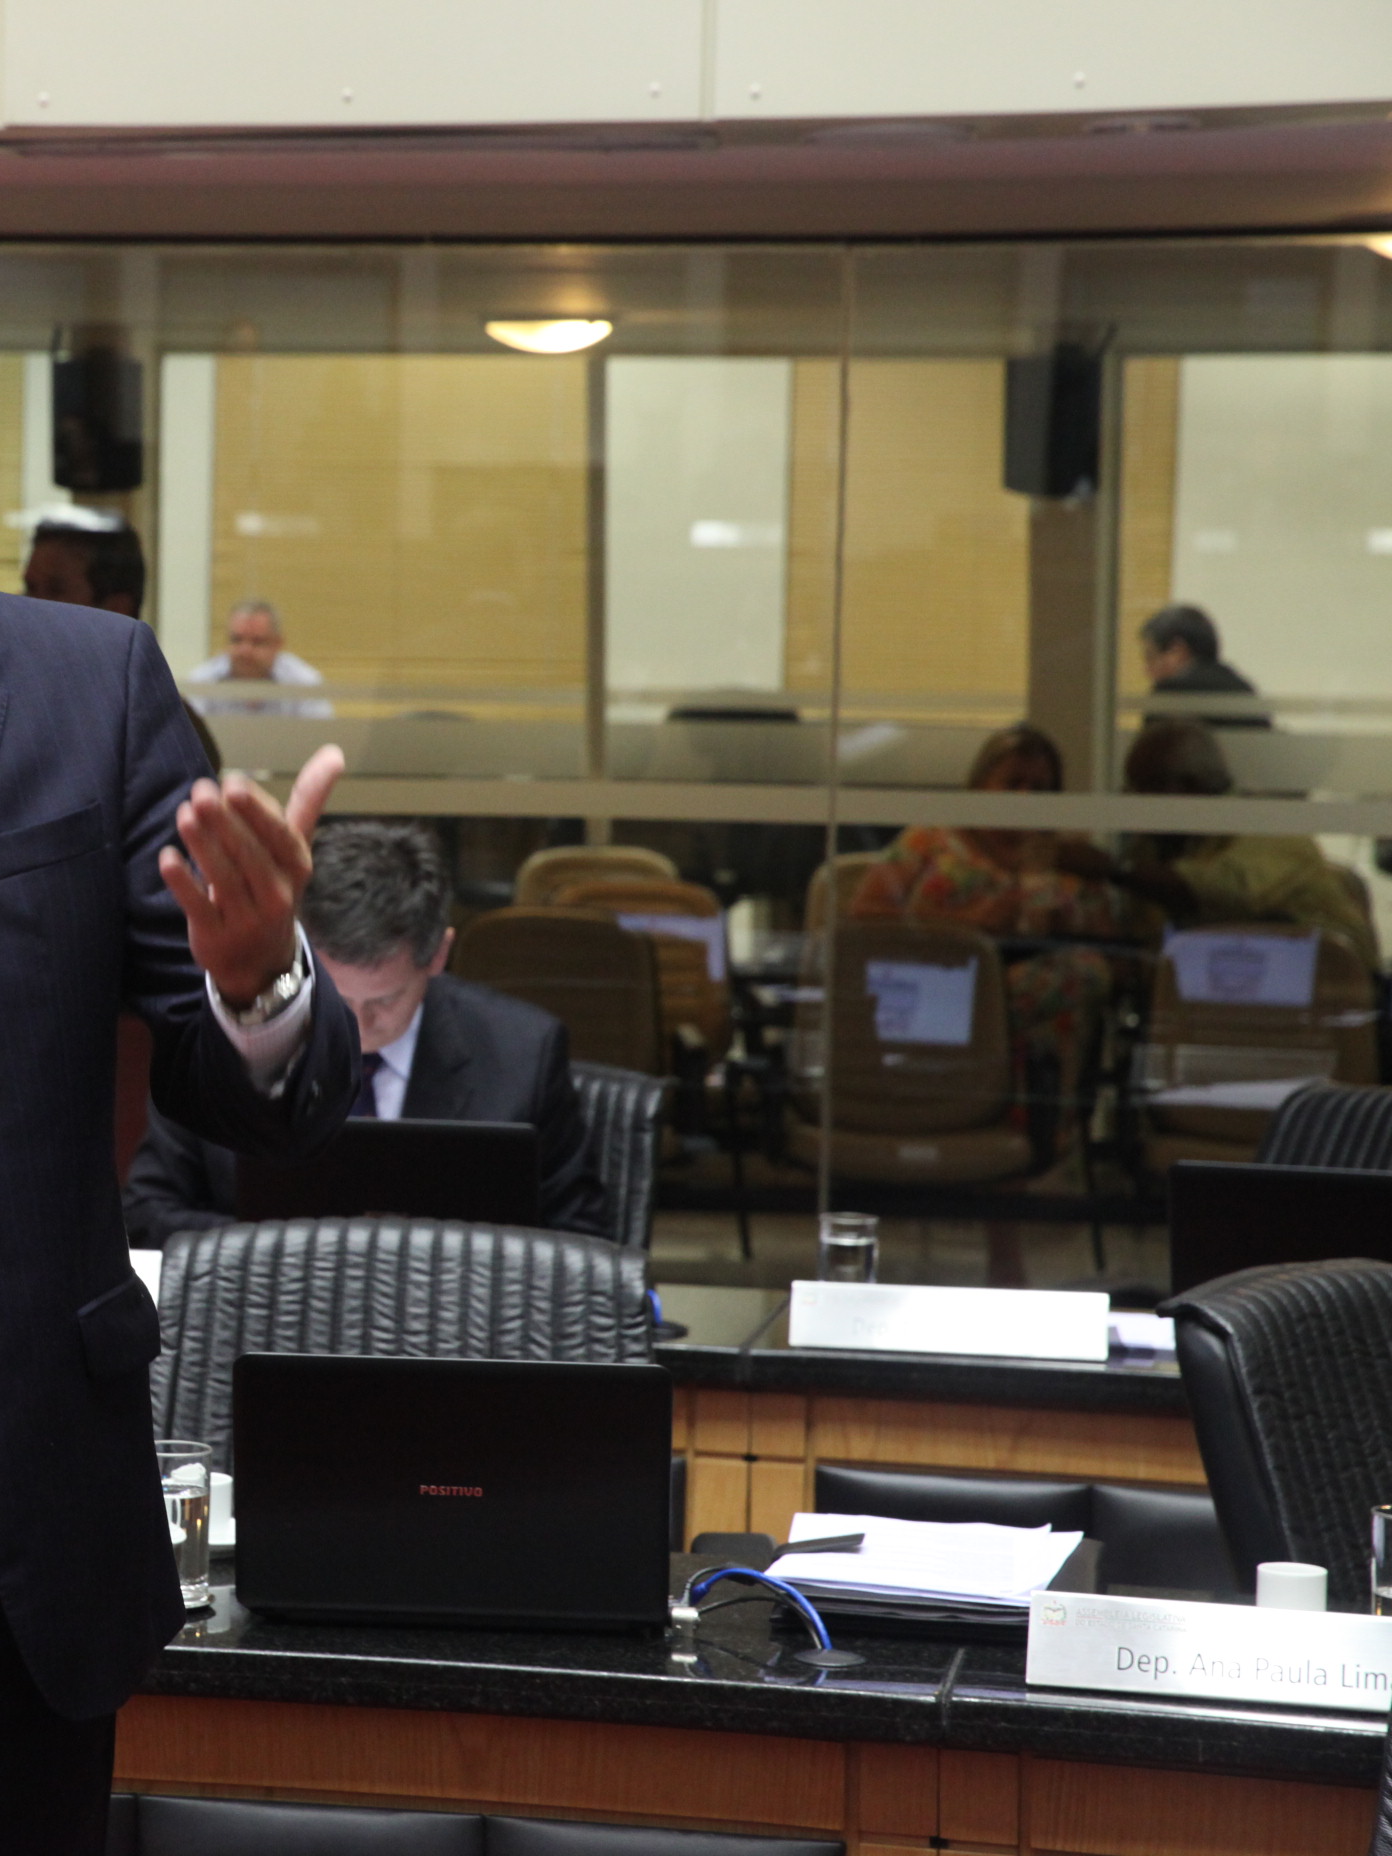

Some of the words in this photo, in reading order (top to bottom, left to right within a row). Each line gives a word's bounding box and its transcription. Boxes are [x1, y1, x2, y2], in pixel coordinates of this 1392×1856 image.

[419, 1485, 483, 1497] POSITIVO
[1116, 1646, 1177, 1681] Dep.
[1189, 1653, 1242, 1679] Ana
[1256, 1656, 1328, 1686] Paula
[1341, 1663, 1392, 1692] Lim
